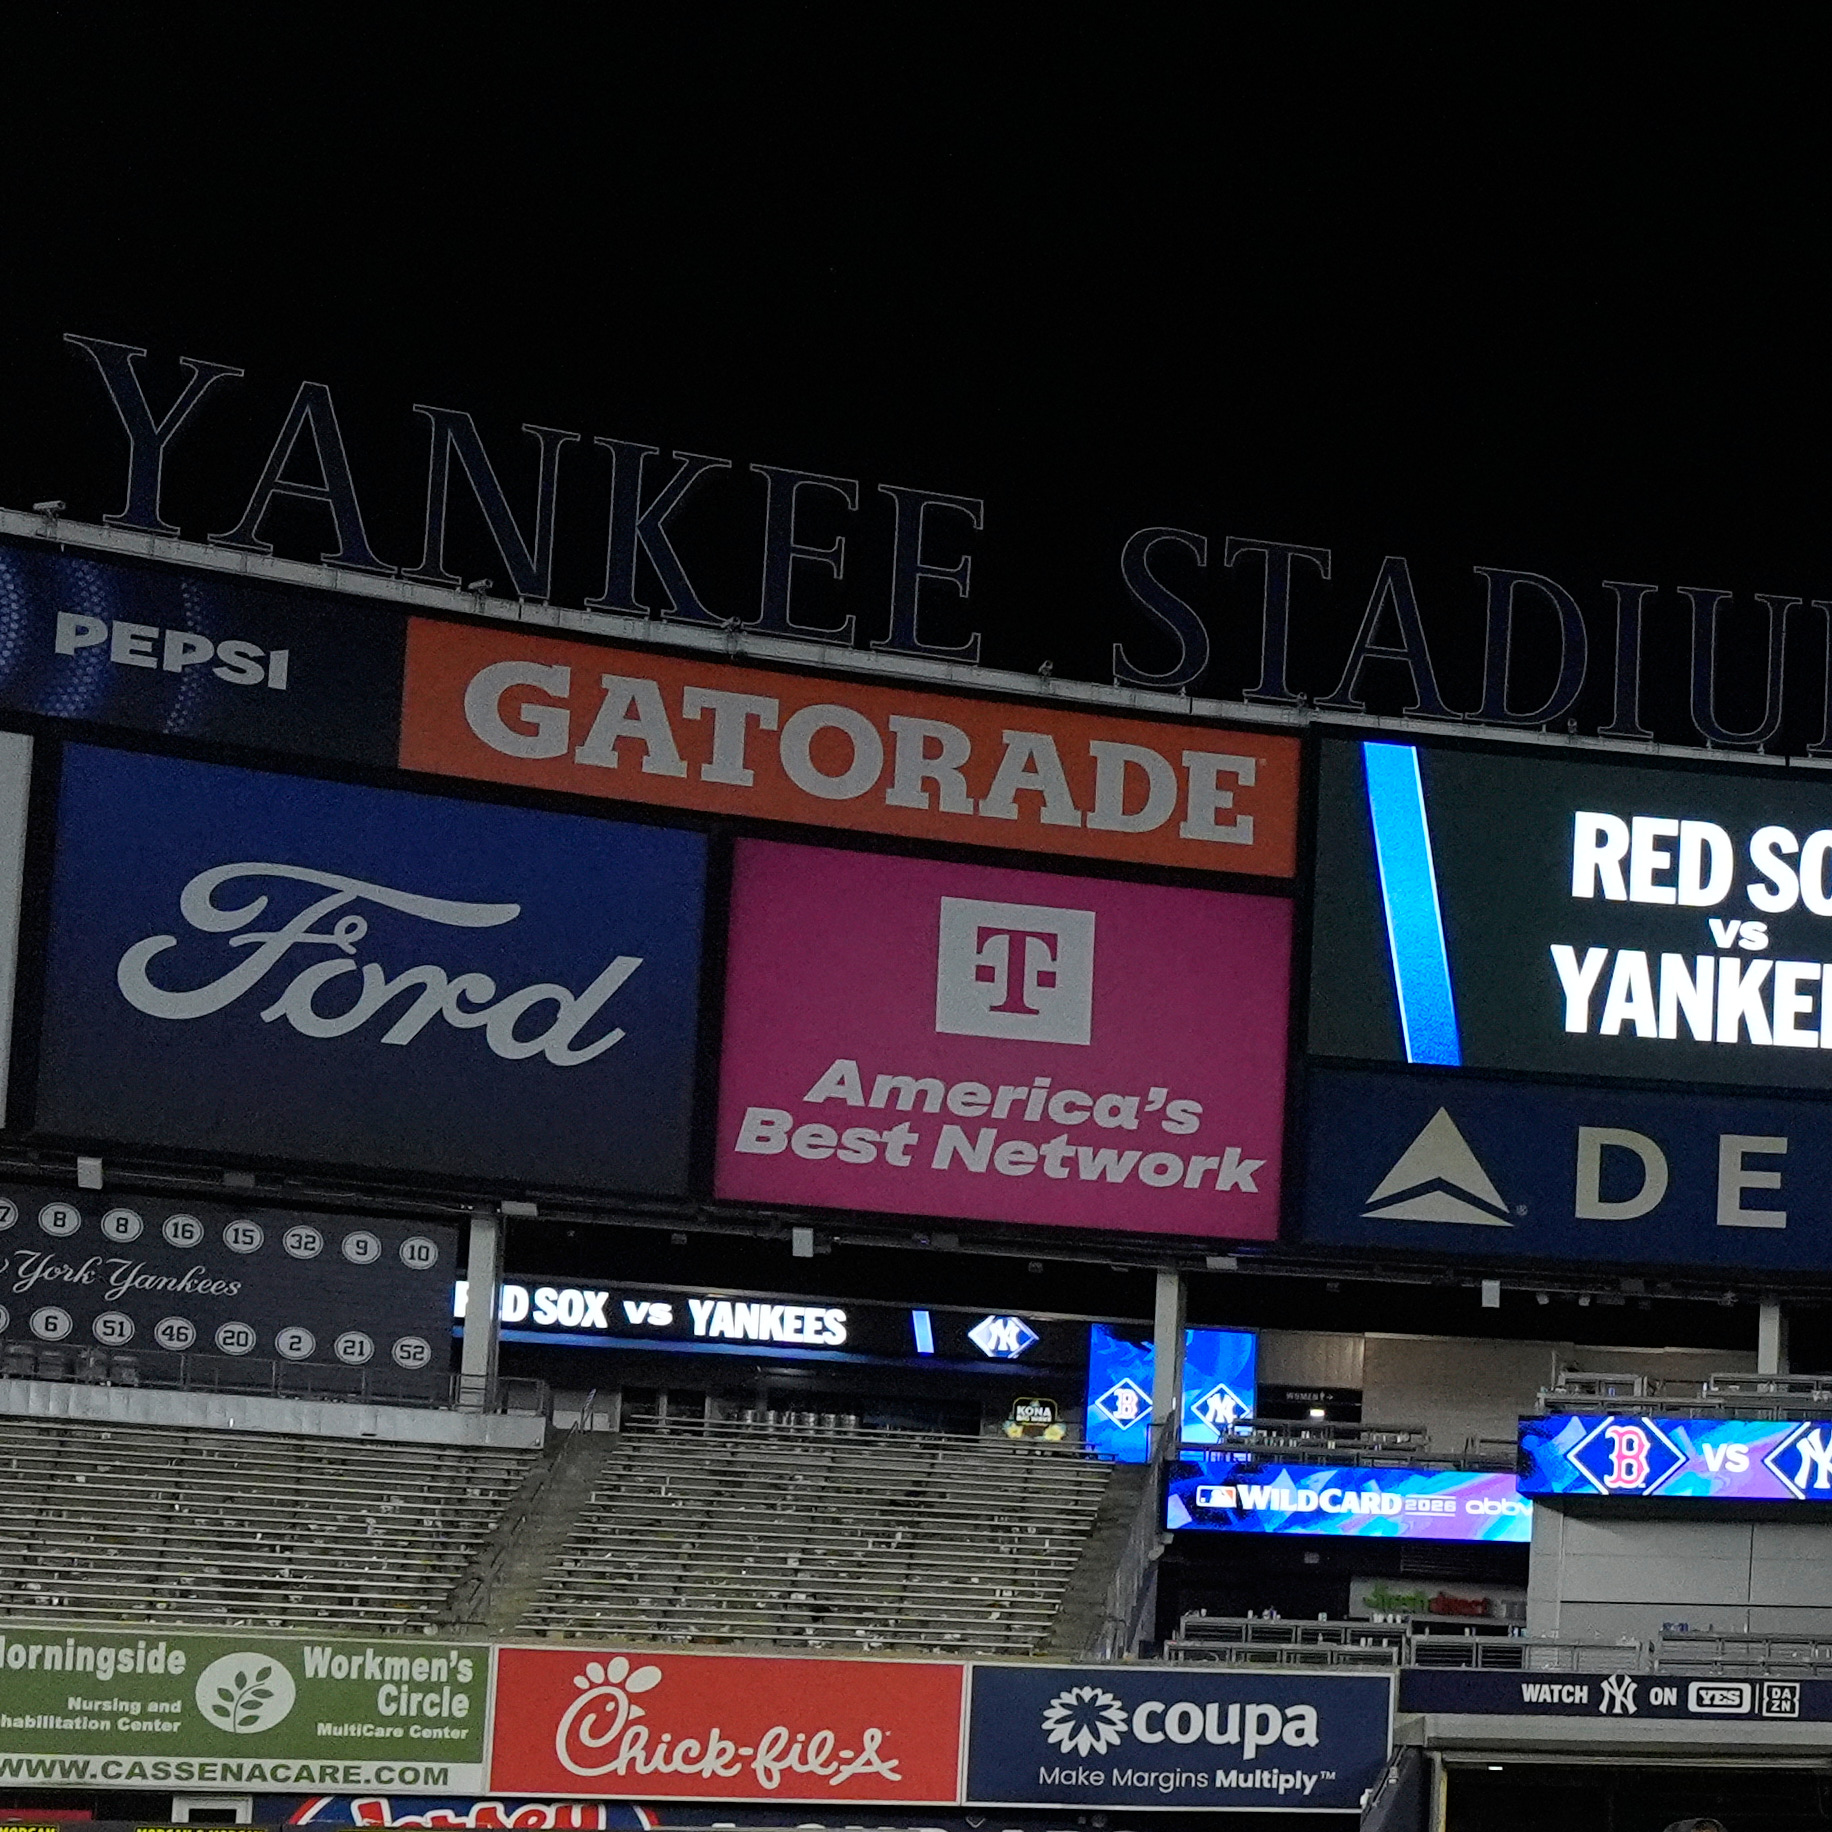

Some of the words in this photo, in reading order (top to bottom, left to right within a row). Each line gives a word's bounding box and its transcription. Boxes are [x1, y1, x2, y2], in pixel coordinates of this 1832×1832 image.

[63, 332, 984, 663] YANKEE
[54, 611, 290, 690] PEPSI
[464, 660, 1256, 849] GATORADE
[1571, 810, 1735, 908] RED
[116, 861, 643, 1070] Ford
[802, 1058, 1203, 1137] America's
[734, 1106, 916, 1169] Best
[932, 1121, 1267, 1197] Network
[53, 1211, 67, 1228] 8
[115, 1216, 129, 1234] 8
[171, 1222, 195, 1239] 16
[231, 1229, 255, 1246] 15
[290, 1234, 317, 1252] 32
[355, 1239, 368, 1256] 9
[407, 1246, 430, 1262] 10
[12, 1249, 102, 1294] York
[99, 1257, 242, 1302] Yankees
[44, 1316, 58, 1333] 6
[533, 1286, 610, 1329] SOX
[687, 1299, 848, 1347] YANKEES
[101, 1320, 127, 1338] 51
[161, 1325, 189, 1343] 46
[222, 1330, 250, 1348] 20
[289, 1335, 302, 1352] 2
[342, 1340, 366, 1357] 21
[399, 1345, 426, 1361] 52
[1016, 1405, 1052, 1416] KONA
[303, 1645, 474, 1684] Workmen's
[377, 1684, 470, 1719] Circle
[1521, 1682, 1589, 1704] WATCH
[1649, 1685, 1677, 1707] ON
[1699, 1687, 1741, 1707] YES
[68, 1696, 142, 1715] Nursing
[147, 1697, 182, 1714] and
[117, 1716, 182, 1733] Center
[316, 1721, 404, 1738] MultiCare
[409, 1724, 469, 1740] Center
[556, 1657, 902, 1791] Chick-fil-A
[1131, 1696, 1320, 1761] coupa
[0, 1756, 449, 1787] WWW.CASSENACARE.COM
[1039, 1765, 1106, 1787] Make
[1112, 1768, 1210, 1795] Margins
